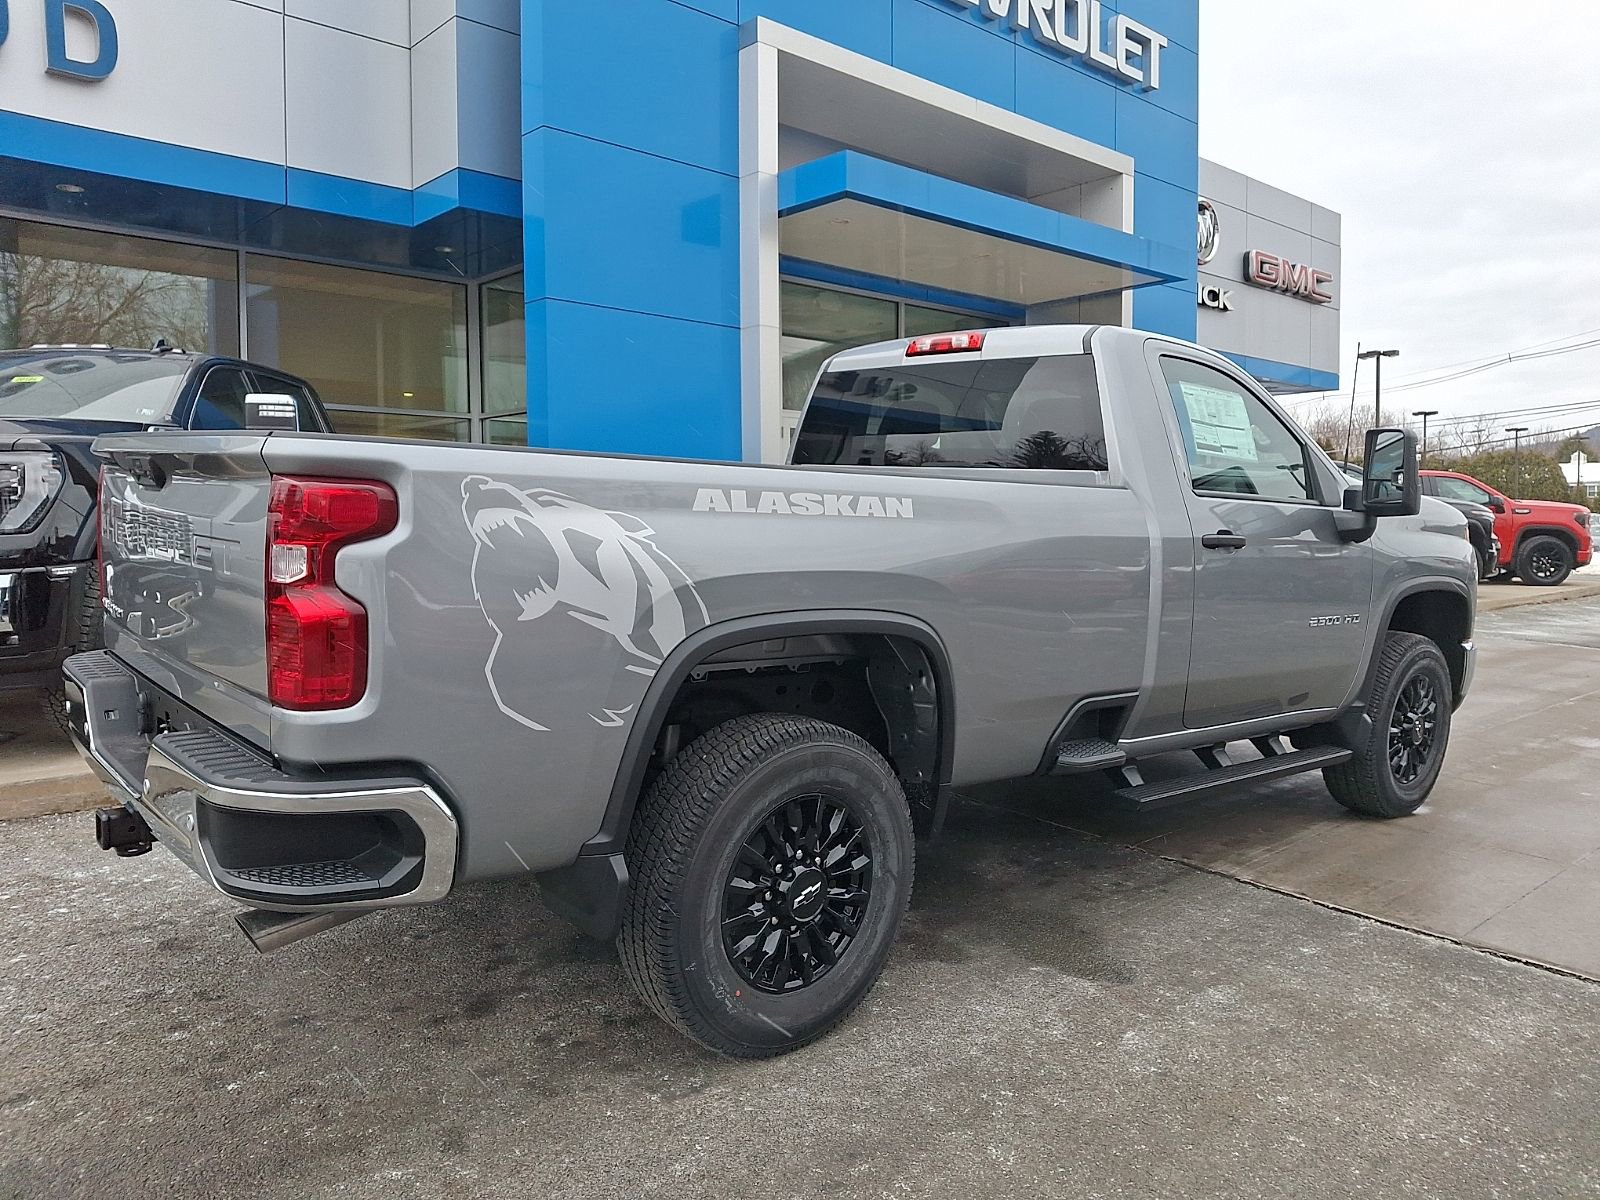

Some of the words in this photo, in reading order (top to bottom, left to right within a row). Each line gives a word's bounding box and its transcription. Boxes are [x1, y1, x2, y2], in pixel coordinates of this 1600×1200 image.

[0, 0, 119, 82] D
[937, 0, 1168, 90] ROLET
[1197, 282, 1234, 312] ICK
[1243, 249, 1333, 304] GMC
[692, 487, 914, 519] ALASKAN
[1343, 613, 1360, 624] HD
